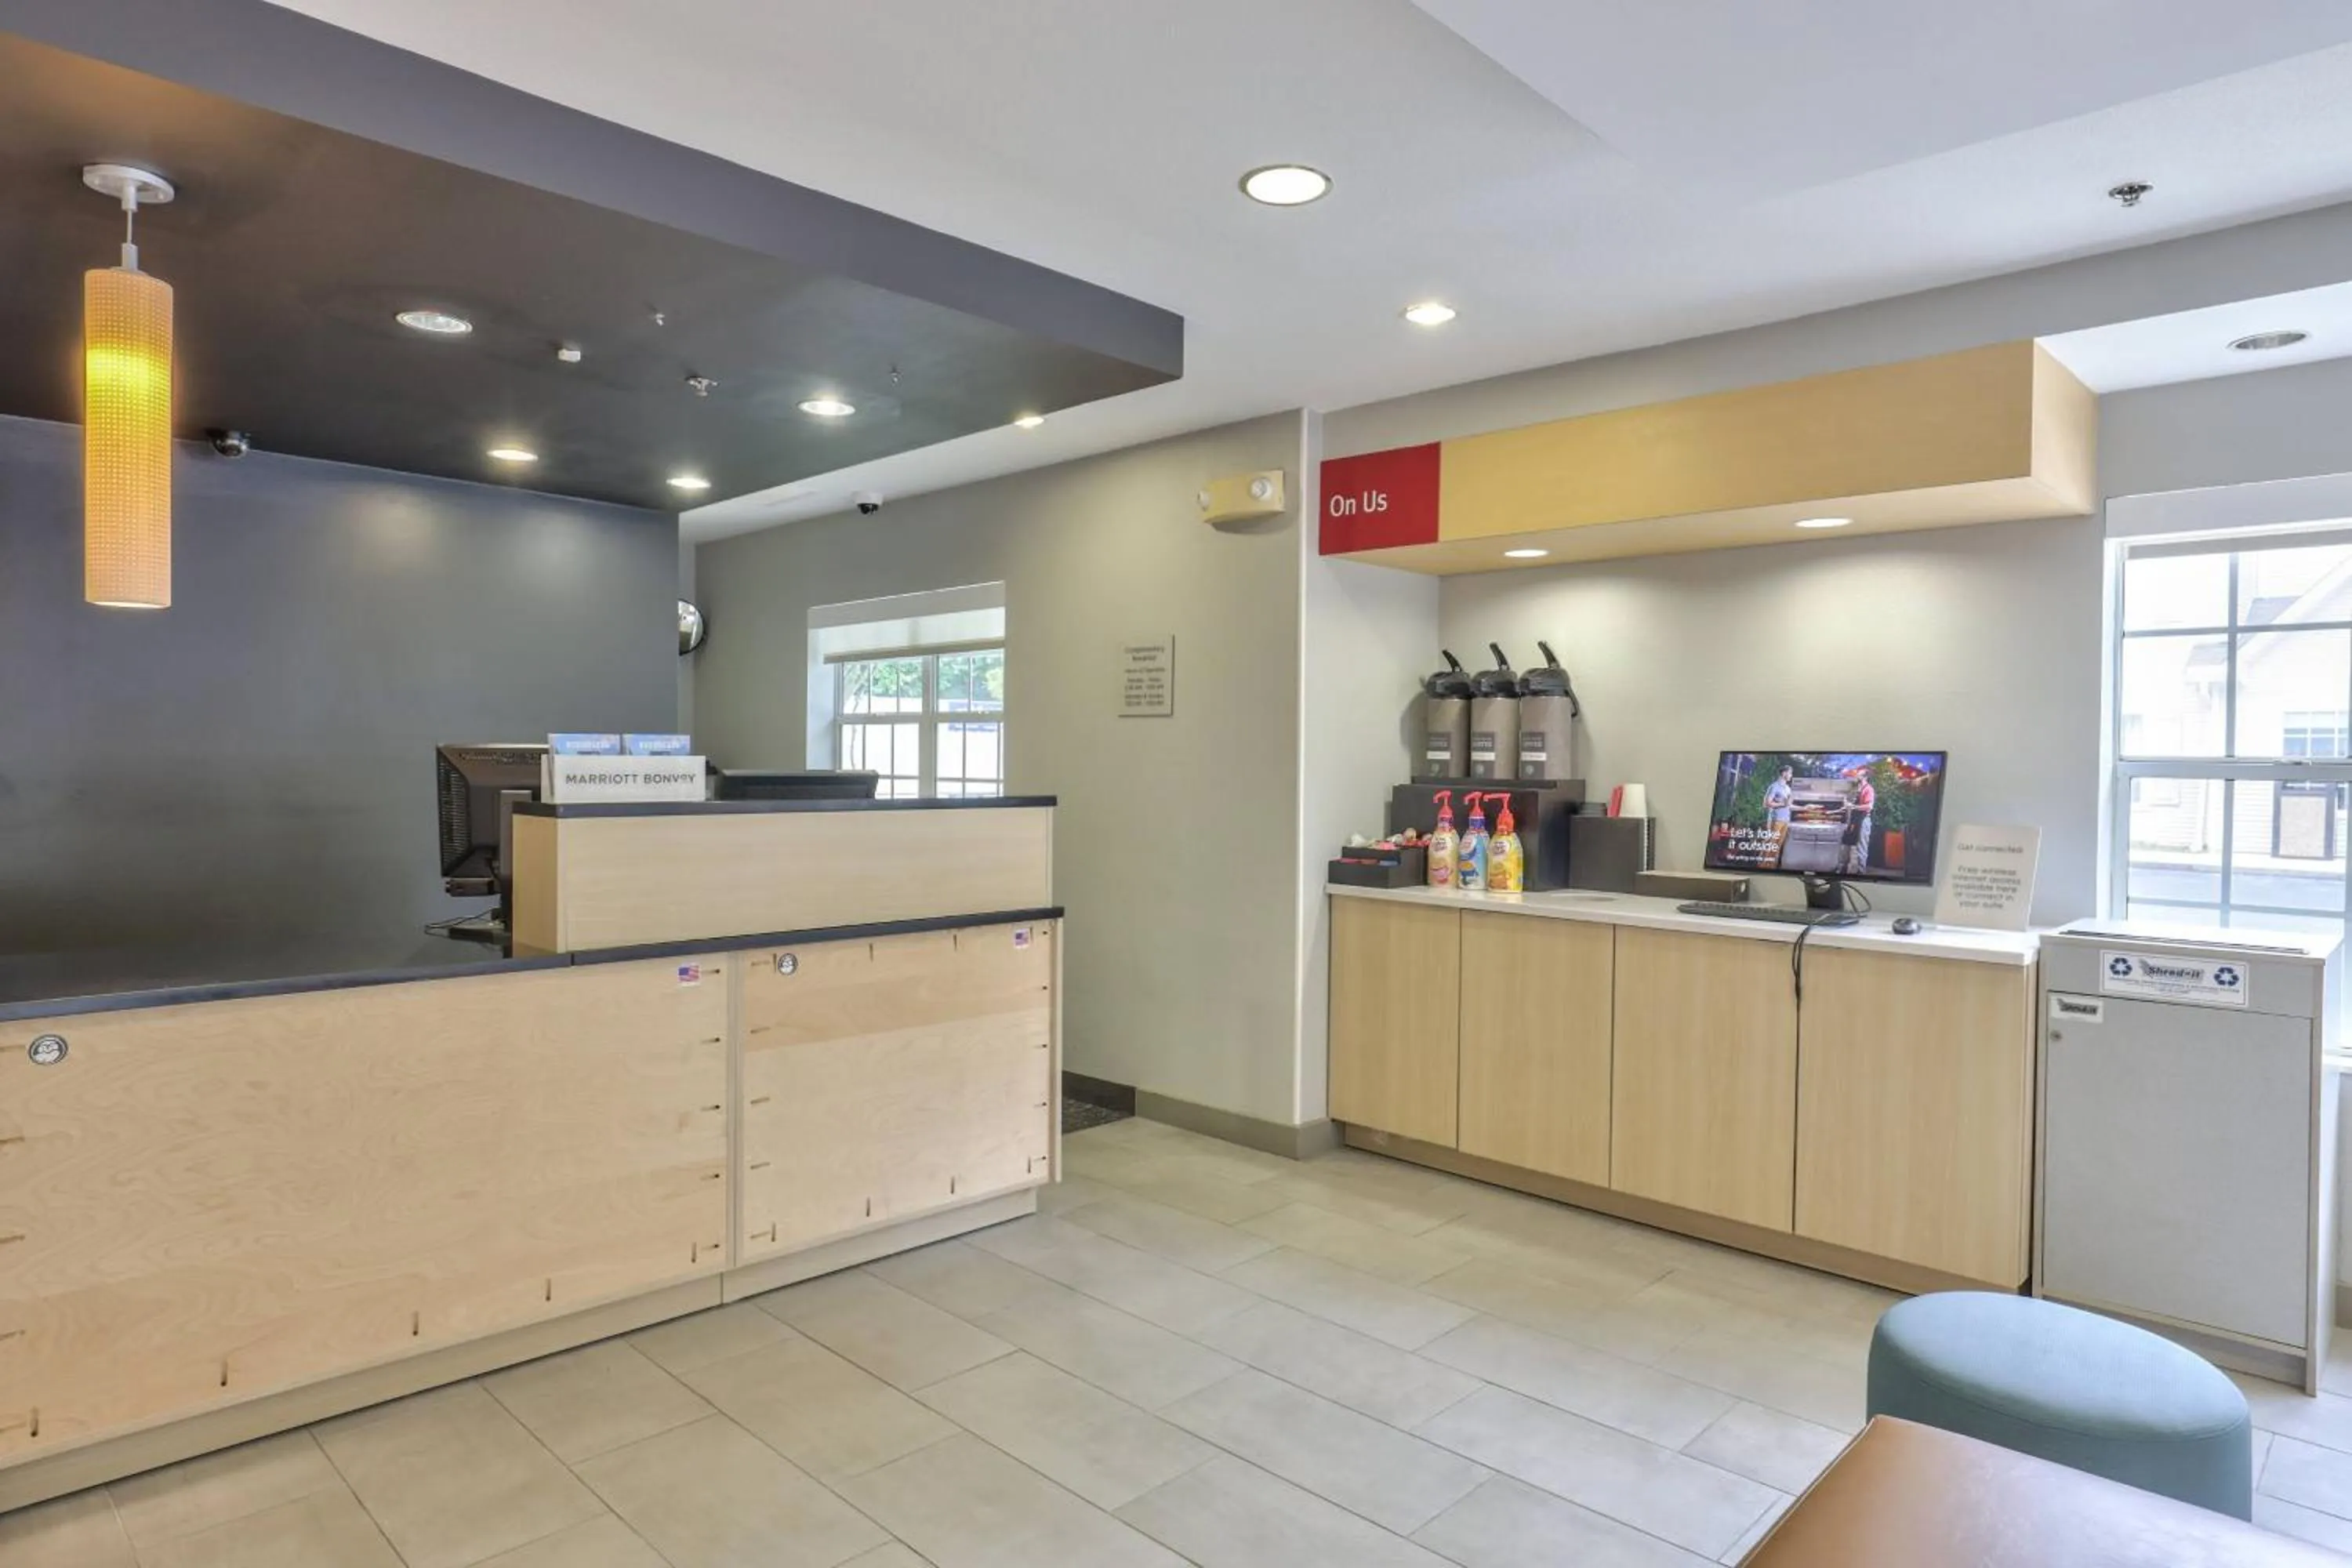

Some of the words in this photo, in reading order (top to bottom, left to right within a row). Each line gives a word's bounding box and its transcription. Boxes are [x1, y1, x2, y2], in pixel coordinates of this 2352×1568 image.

[1330, 495, 1356, 517] On
[1363, 489, 1388, 513] Us
[565, 774, 638, 784] MARRIOTT
[644, 774, 695, 784] BONVOY
[1730, 827, 1754, 838] Let's
[1757, 826, 1781, 839] take
[1728, 839, 1737, 849] it
